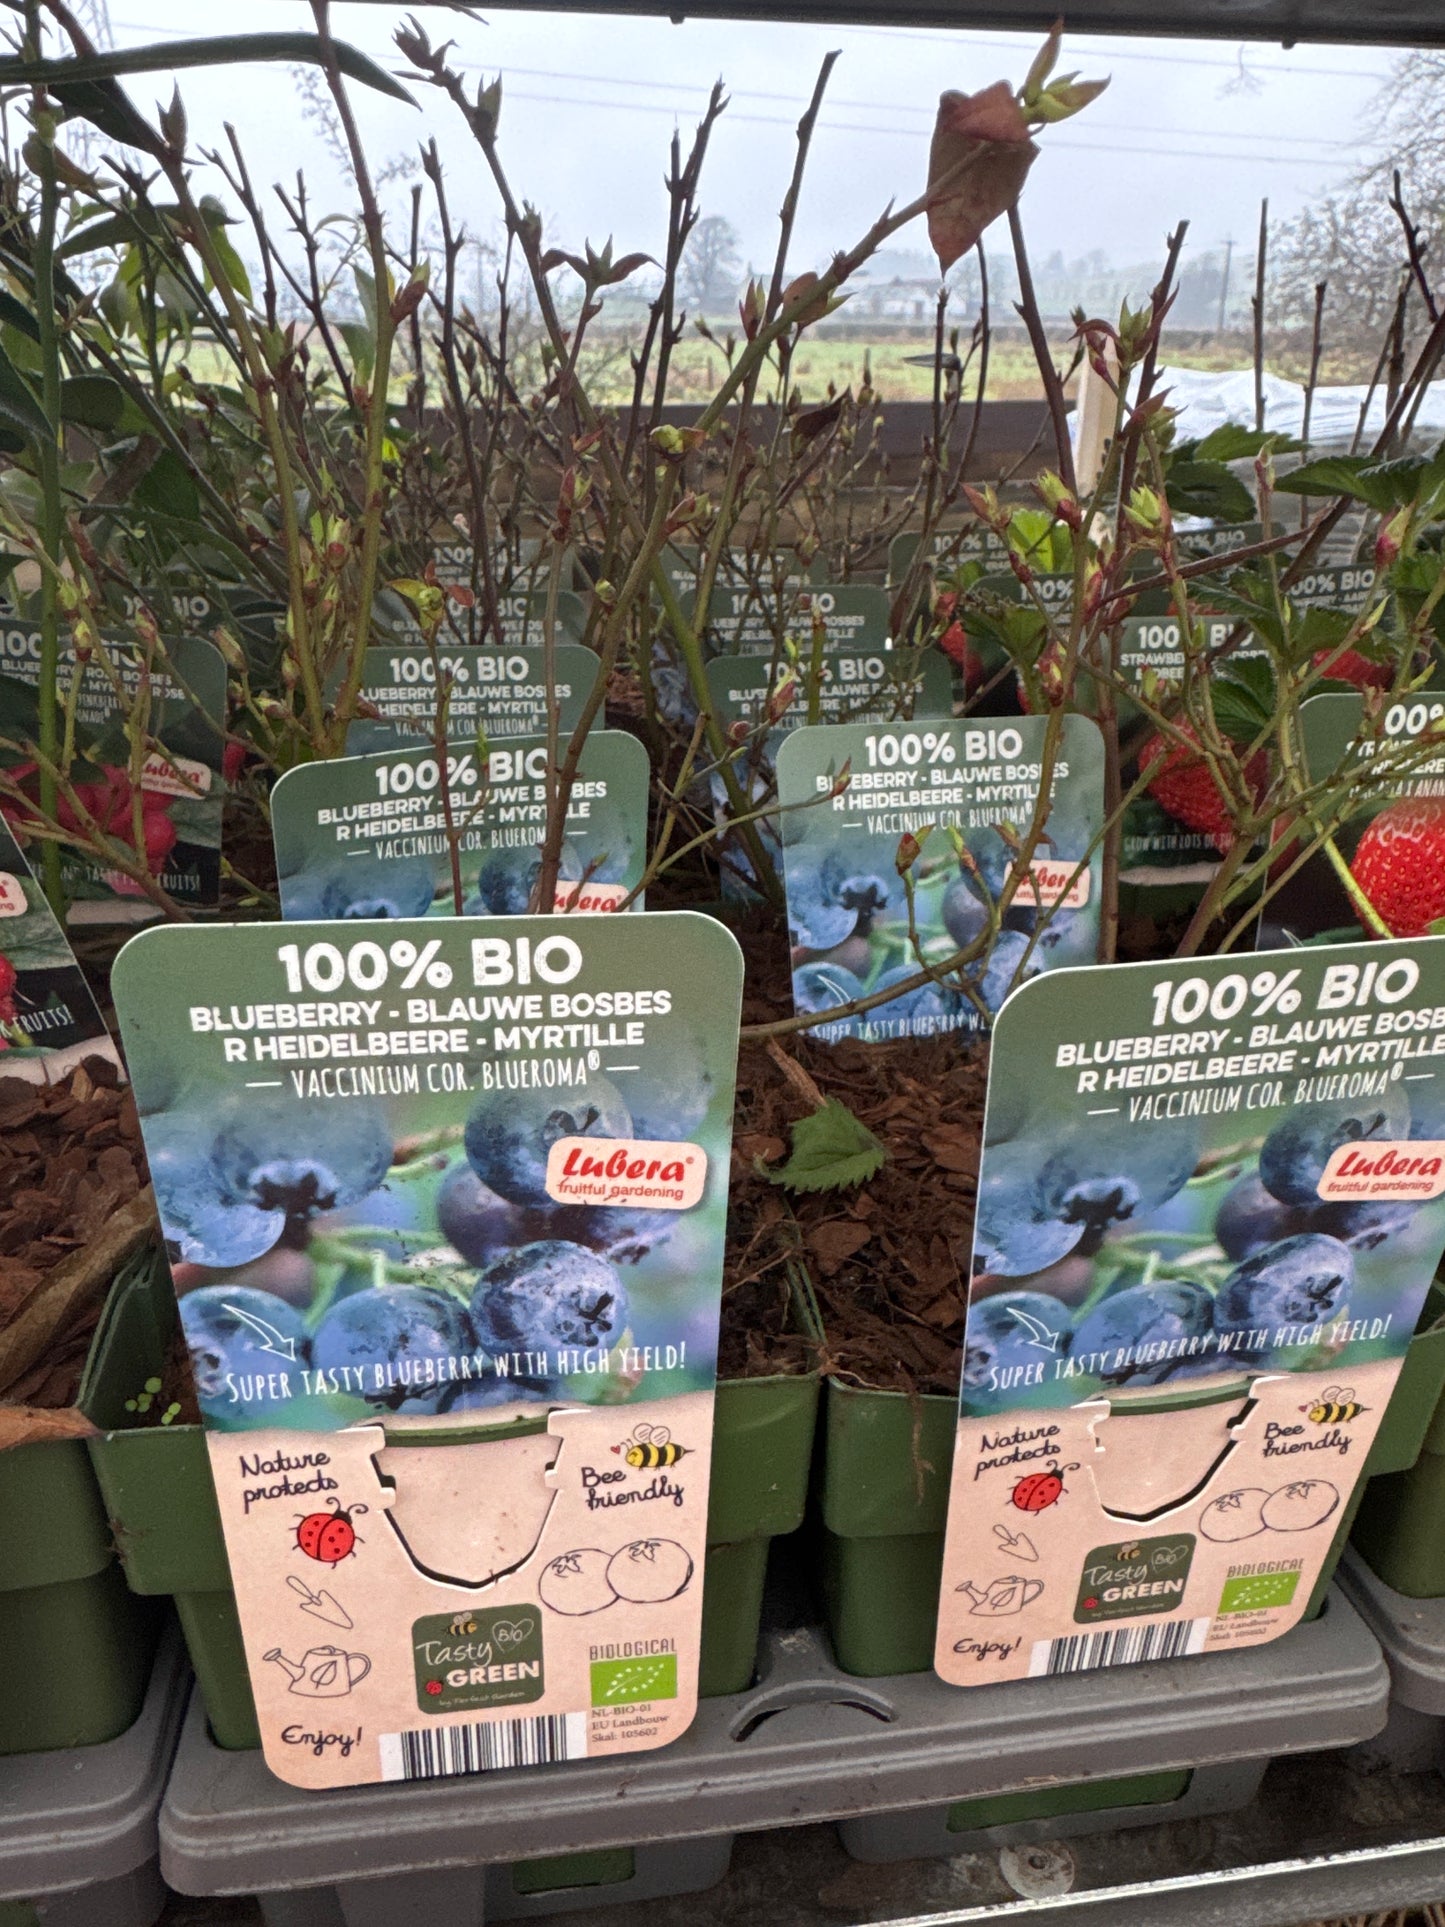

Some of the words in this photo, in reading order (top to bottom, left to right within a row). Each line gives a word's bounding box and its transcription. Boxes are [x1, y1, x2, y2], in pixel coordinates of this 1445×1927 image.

[1340, 568, 1376, 591] BIO
[390, 656, 470, 683] 100%
[477, 655, 530, 682] BIO
[838, 656, 885, 681] BIO
[359, 687, 437, 701] LUEBERRY
[514, 684, 572, 698] BOSES
[818, 683, 870, 697] LAUWE
[488, 701, 549, 715] MYRTILL
[865, 731, 956, 768] 100%
[965, 728, 1023, 762] BIO
[375, 755, 478, 796] 100%
[488, 747, 548, 783] BIO
[816, 770, 918, 792] BLEBERRY
[930, 765, 1003, 786] BLAUWE
[1005, 761, 1070, 780] BOSES
[317, 794, 434, 825] BLUEBERRY
[534, 781, 608, 801] BBES
[832, 797, 846, 812] R
[849, 789, 964, 811] HEIDELBEERE
[976, 781, 1057, 804] MYRTIL
[336, 825, 351, 841] R
[498, 801, 591, 824] MYRTLE
[867, 811, 937, 835] VACCINIUM
[491, 826, 548, 849] BLUEROM
[277, 937, 454, 994] 100%
[470, 934, 584, 988] BIO
[1151, 968, 1303, 1027] 100%
[1316, 957, 1421, 1011] BIO
[12, 1003, 75, 1034] FRUITS!
[189, 999, 383, 1033] BLUEBERRY
[406, 994, 543, 1024] BLAUWE
[549, 989, 673, 1019] BOSBES
[223, 1037, 248, 1063] R
[255, 1028, 470, 1061] HEIDELBEERE
[493, 1021, 645, 1051] MYRTILLE
[856, 1017, 894, 1041] TASTY
[1055, 1028, 1232, 1068] BLUEBERRY
[1248, 1014, 1370, 1049] BLAUWE
[1373, 1005, 1445, 1036] BOSB
[1077, 1070, 1097, 1095] R
[1103, 1049, 1297, 1091] HEIDELBEERE
[1315, 1033, 1445, 1069] MYRTILLE
[289, 1065, 420, 1100] VACCINIUM
[426, 1062, 475, 1093] COR.
[1128, 1085, 1241, 1122] VACCINIUM
[1246, 1081, 1288, 1110] COR.
[557, 1178, 606, 1196] fruitful
[610, 1183, 685, 1201] gardening
[1326, 1179, 1370, 1193] fruitful
[1371, 1179, 1435, 1194] gardening
[1054, 1351, 1108, 1380] TASTY
[1113, 1332, 1215, 1368] BLUEBERRY
[1217, 1325, 1269, 1353] WITH
[1271, 1321, 1325, 1348] HIGH
[1328, 1313, 1394, 1343] YIELD!
[300, 1364, 368, 1397] TASTY
[374, 1355, 486, 1390] BLUEBERRY
[492, 1351, 549, 1378] WITH
[555, 1347, 612, 1376] HIGH
[617, 1340, 688, 1373] YIELD!
[979, 1423, 1061, 1454] Nature
[1262, 1430, 1353, 1458] friendly
[1263, 1421, 1307, 1441] Bee
[238, 1449, 333, 1479] Nature
[973, 1441, 1062, 1481] protects
[580, 1465, 627, 1490] Bee
[242, 1470, 340, 1515] protects
[585, 1480, 685, 1513] friendly
[1083, 1564, 1148, 1587] Tasty
[1226, 1557, 1305, 1579] BIOLOGICAL
[1102, 1577, 1184, 1603] GREEN
[497, 1628, 524, 1642] BIO
[589, 1637, 678, 1661] BIOLOGICAL
[953, 1635, 1025, 1662] Enjoy!
[415, 1640, 493, 1668] Tasty
[446, 1660, 540, 1688] GREEN
[591, 1703, 652, 1719] NL-BIO-01
[591, 1720, 610, 1731] EU
[612, 1715, 670, 1728] Landbouw
[281, 1724, 363, 1758] Enjoy!
